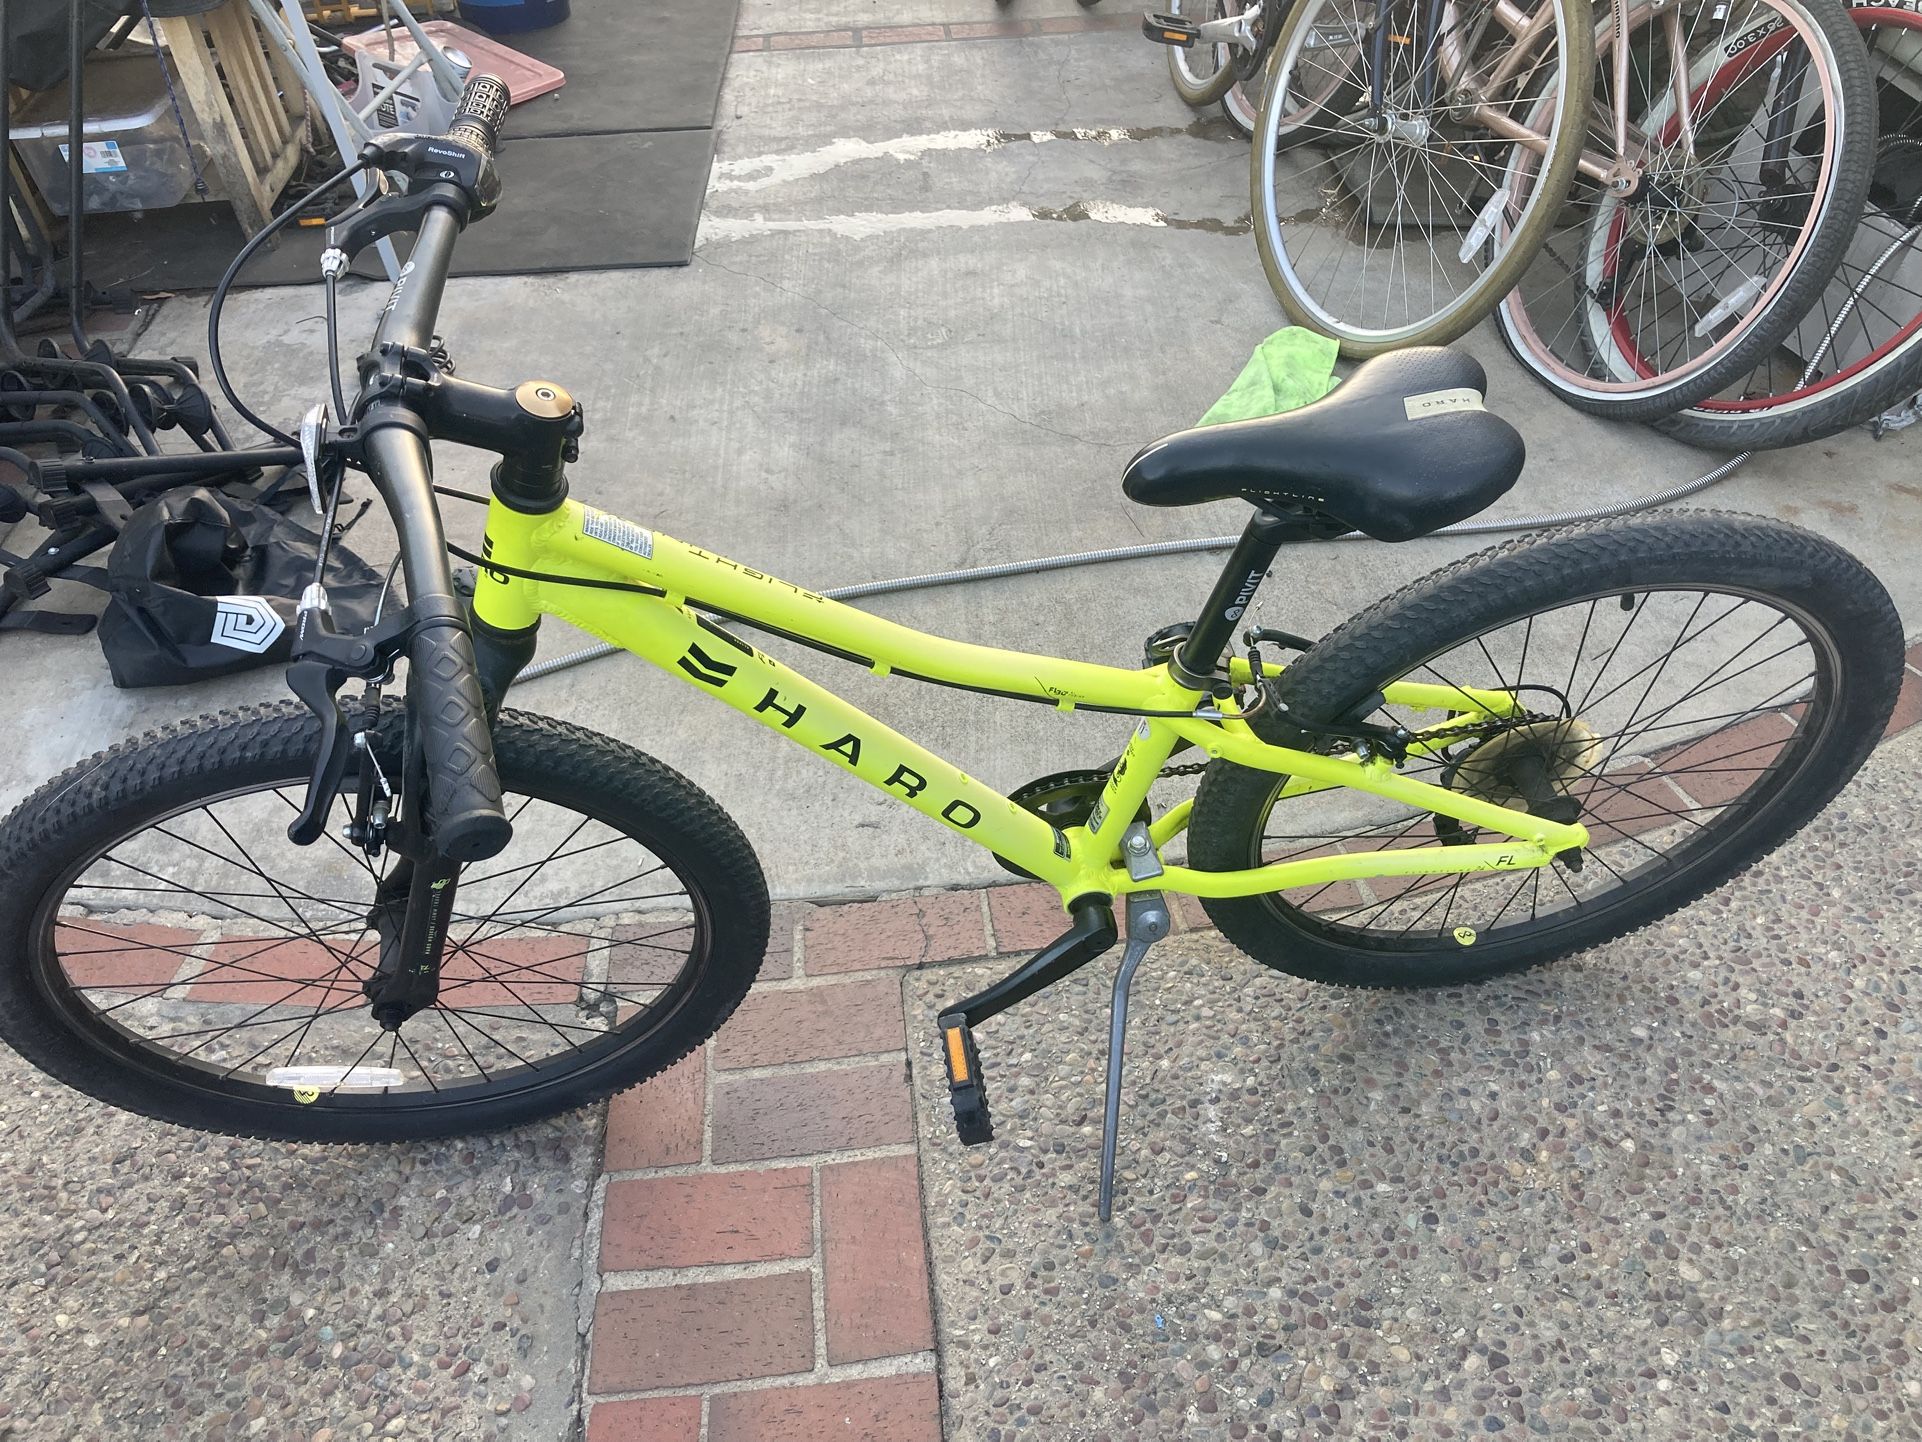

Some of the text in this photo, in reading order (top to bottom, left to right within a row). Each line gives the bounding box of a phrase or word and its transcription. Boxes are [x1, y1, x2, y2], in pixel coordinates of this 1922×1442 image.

[427, 146, 466, 159] RevoShift
[1422, 397, 1471, 408] HARO
[1234, 569, 1264, 605] PIVIT
[753, 687, 981, 829] HARO
[1496, 855, 1516, 866] FL
